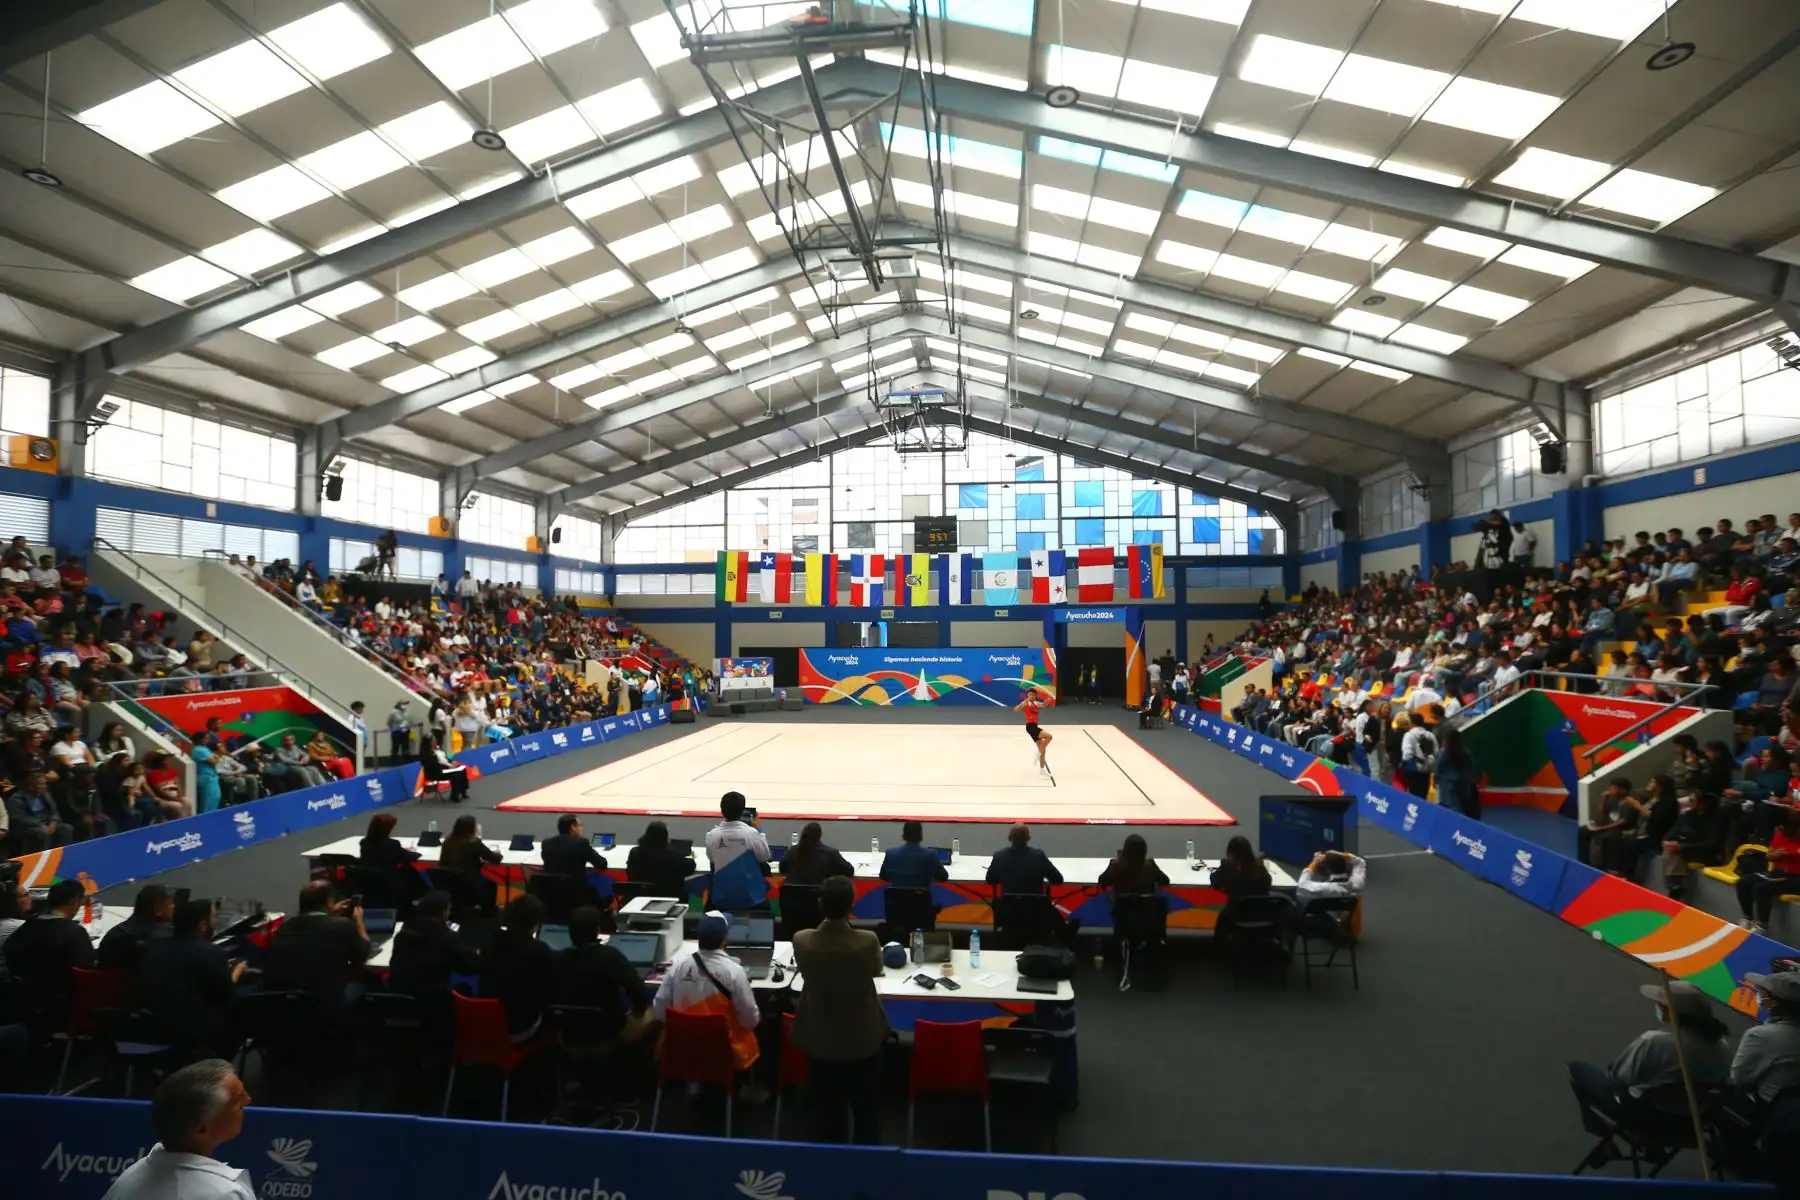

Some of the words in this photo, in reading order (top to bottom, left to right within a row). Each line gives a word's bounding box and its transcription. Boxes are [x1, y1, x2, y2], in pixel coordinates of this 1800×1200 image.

[1066, 611, 1114, 622] Ayacucho2024
[828, 654, 859, 664] Ayacucho
[989, 654, 1021, 664] Ayacucho
[146, 832, 201, 854] Ayacucho
[262, 1181, 313, 1199] ODEBO
